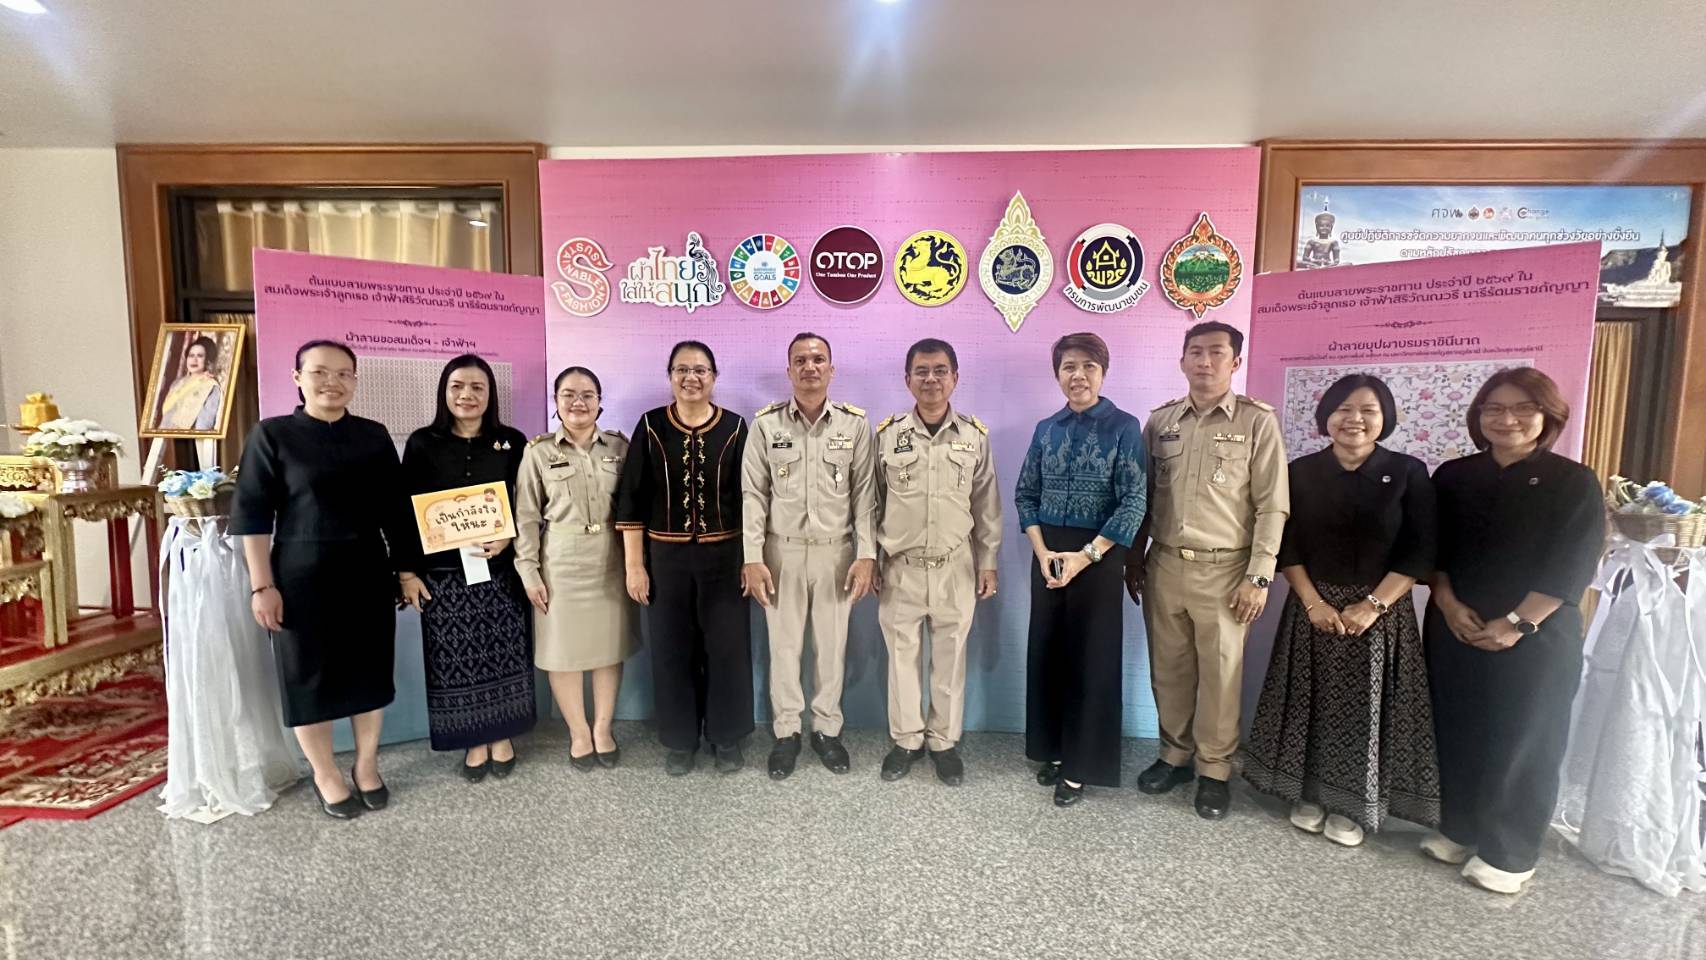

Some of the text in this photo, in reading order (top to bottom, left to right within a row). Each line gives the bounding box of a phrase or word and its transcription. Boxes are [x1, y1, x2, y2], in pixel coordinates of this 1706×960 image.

[562, 242, 603, 289] SUSTAINABLE
[630, 249, 696, 281] ผ้าไทย
[816, 251, 878, 270] OTOP
[264, 284, 540, 316] สมเด็จพระเจ้าลูกเธอ เจ้าฟ้าสิริวัณณวรี นารีรัตนราชกัญญา
[308, 275, 425, 294] ต้นแบบลายพระราชทาน
[428, 285, 463, 298] ประจำปี
[621, 281, 711, 309] ใส่ให้สนุก
[1065, 282, 1149, 312] กรมการพัฒนาชุมชน
[1257, 281, 1589, 314] สมเด็จพระเจ้าลูกเธอ เจ้าฟ้าสิริวัณณวรี นารีรัตนราชกัญญา
[1297, 282, 1422, 300] ต้นแบบลายพระราชทาน
[1426, 274, 1472, 290] ประจำปี
[1518, 270, 1533, 282] ใน
[434, 504, 497, 525] เป็นกำลังใจ
[451, 518, 487, 532] ให้นะ
